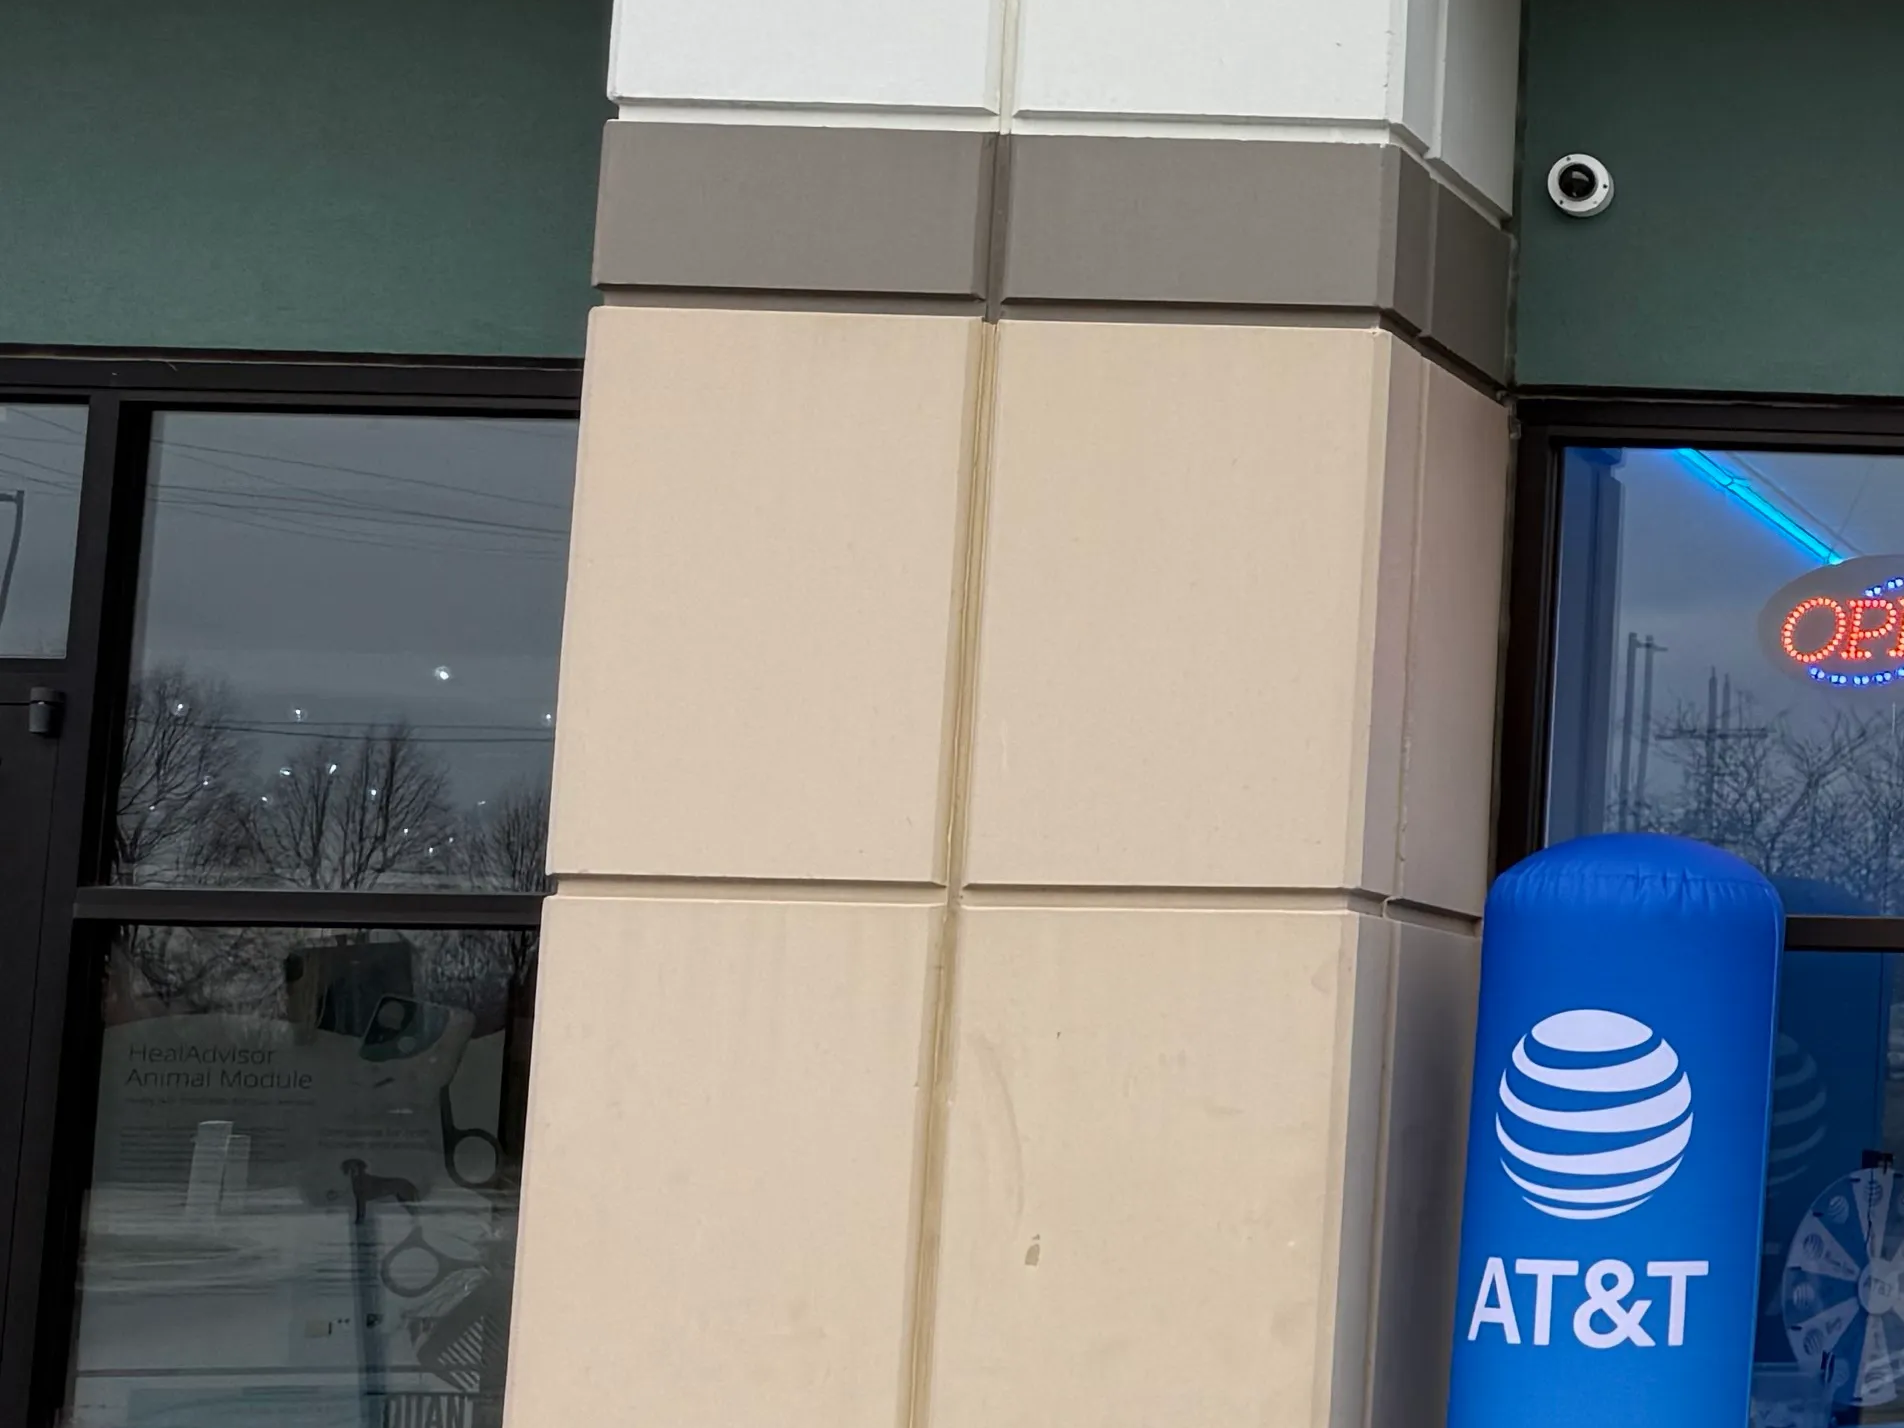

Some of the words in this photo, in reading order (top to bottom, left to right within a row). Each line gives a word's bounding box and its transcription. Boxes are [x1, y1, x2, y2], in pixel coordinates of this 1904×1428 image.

[129, 1044, 277, 1066] HealAdvisor
[125, 1068, 211, 1088] Animal
[220, 1069, 313, 1090] Module
[1467, 1256, 1710, 1349] AT&T
